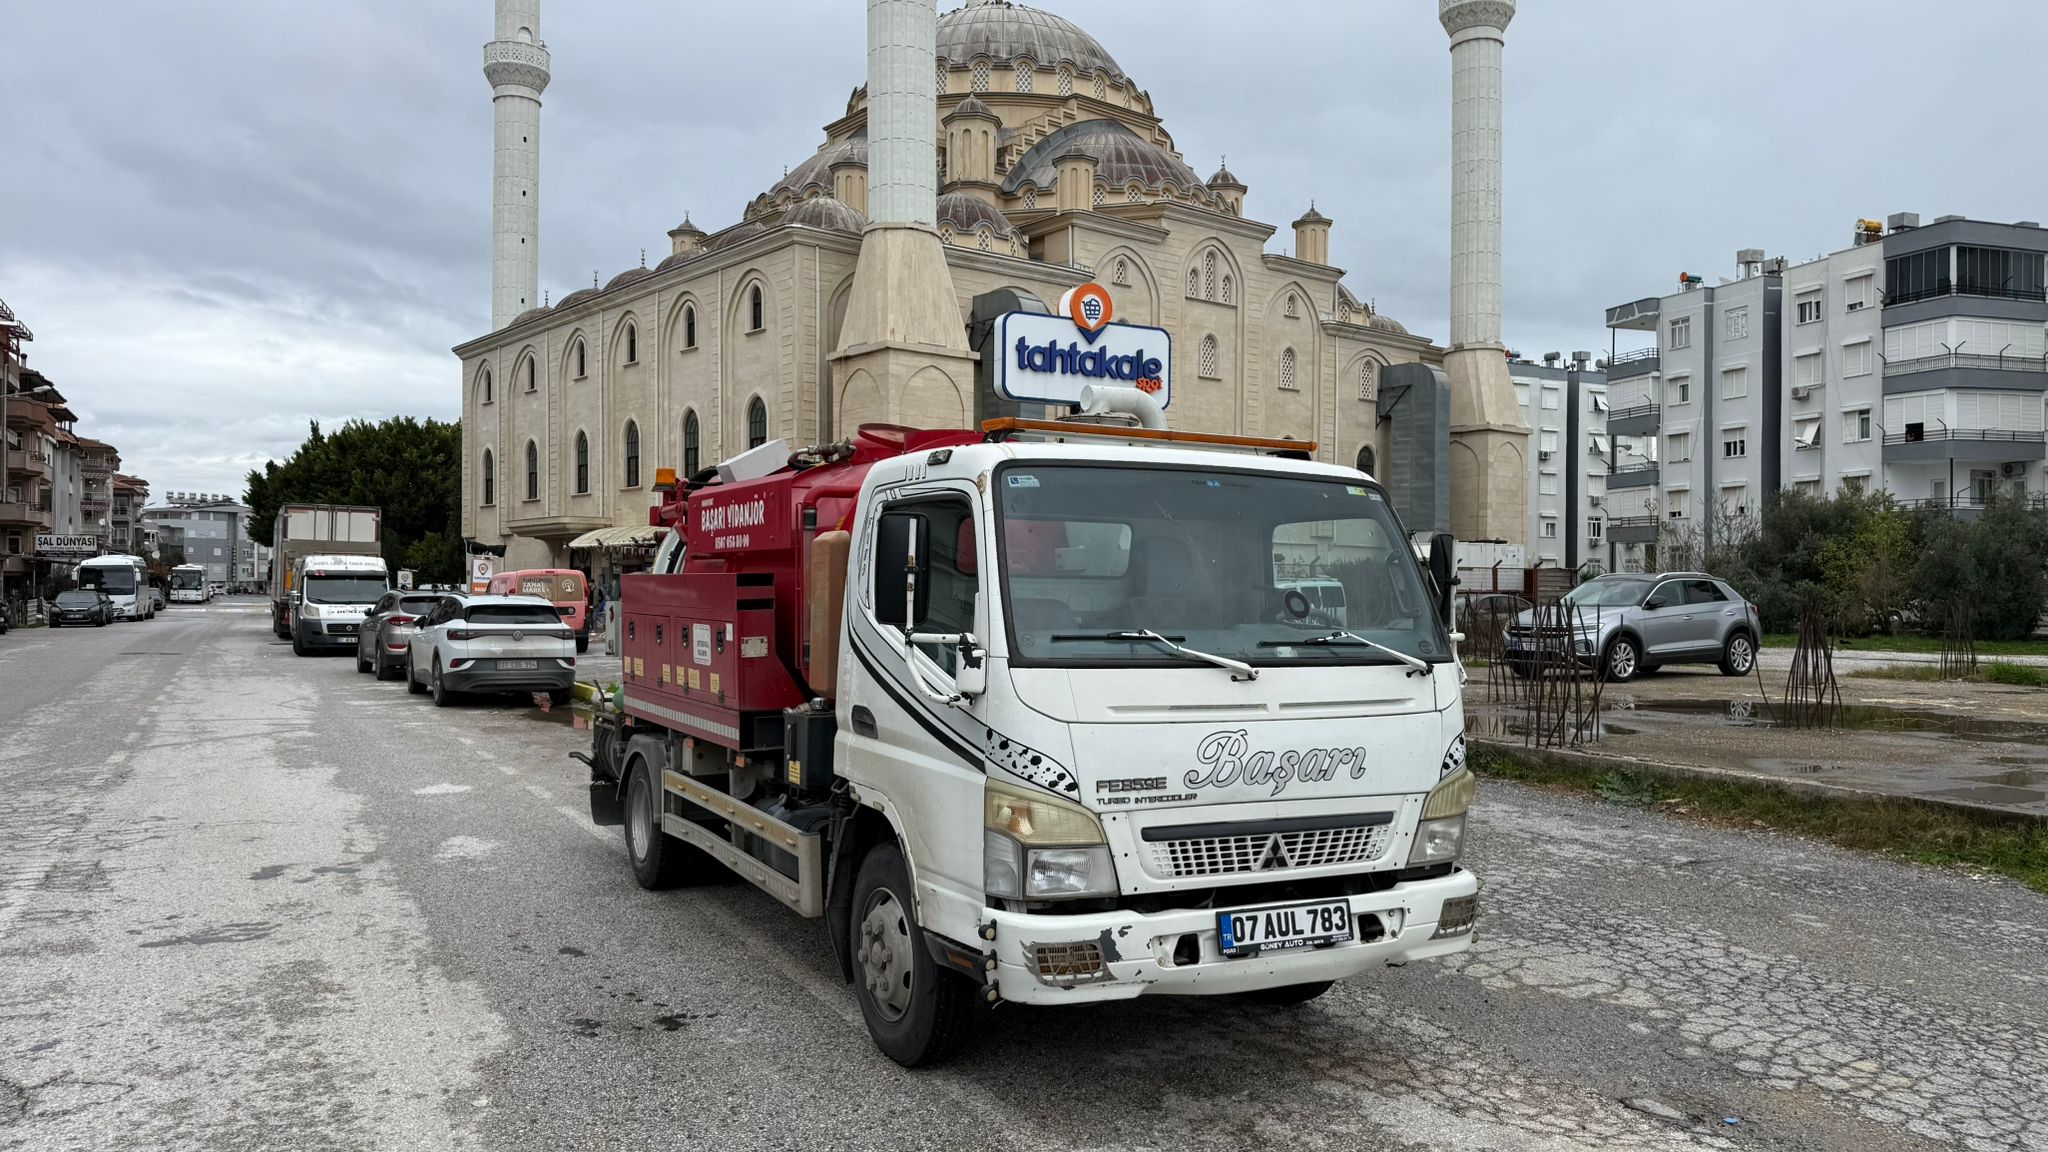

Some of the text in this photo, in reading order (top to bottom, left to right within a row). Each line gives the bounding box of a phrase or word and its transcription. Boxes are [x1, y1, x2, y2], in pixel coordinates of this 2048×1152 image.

[1016, 336, 1162, 380] tahtakale
[1136, 377, 1163, 392] spot
[702, 506, 725, 537] BAŞARI
[37, 536, 95, 548] ŞAL DÜNYASI
[1183, 729, 1367, 797] Başarı
[1096, 793, 1198, 805] TURBO INTERCOOLER
[1232, 906, 1346, 943] 07 AUL 783
[1260, 939, 1304, 951] GÜNEY AUTO
